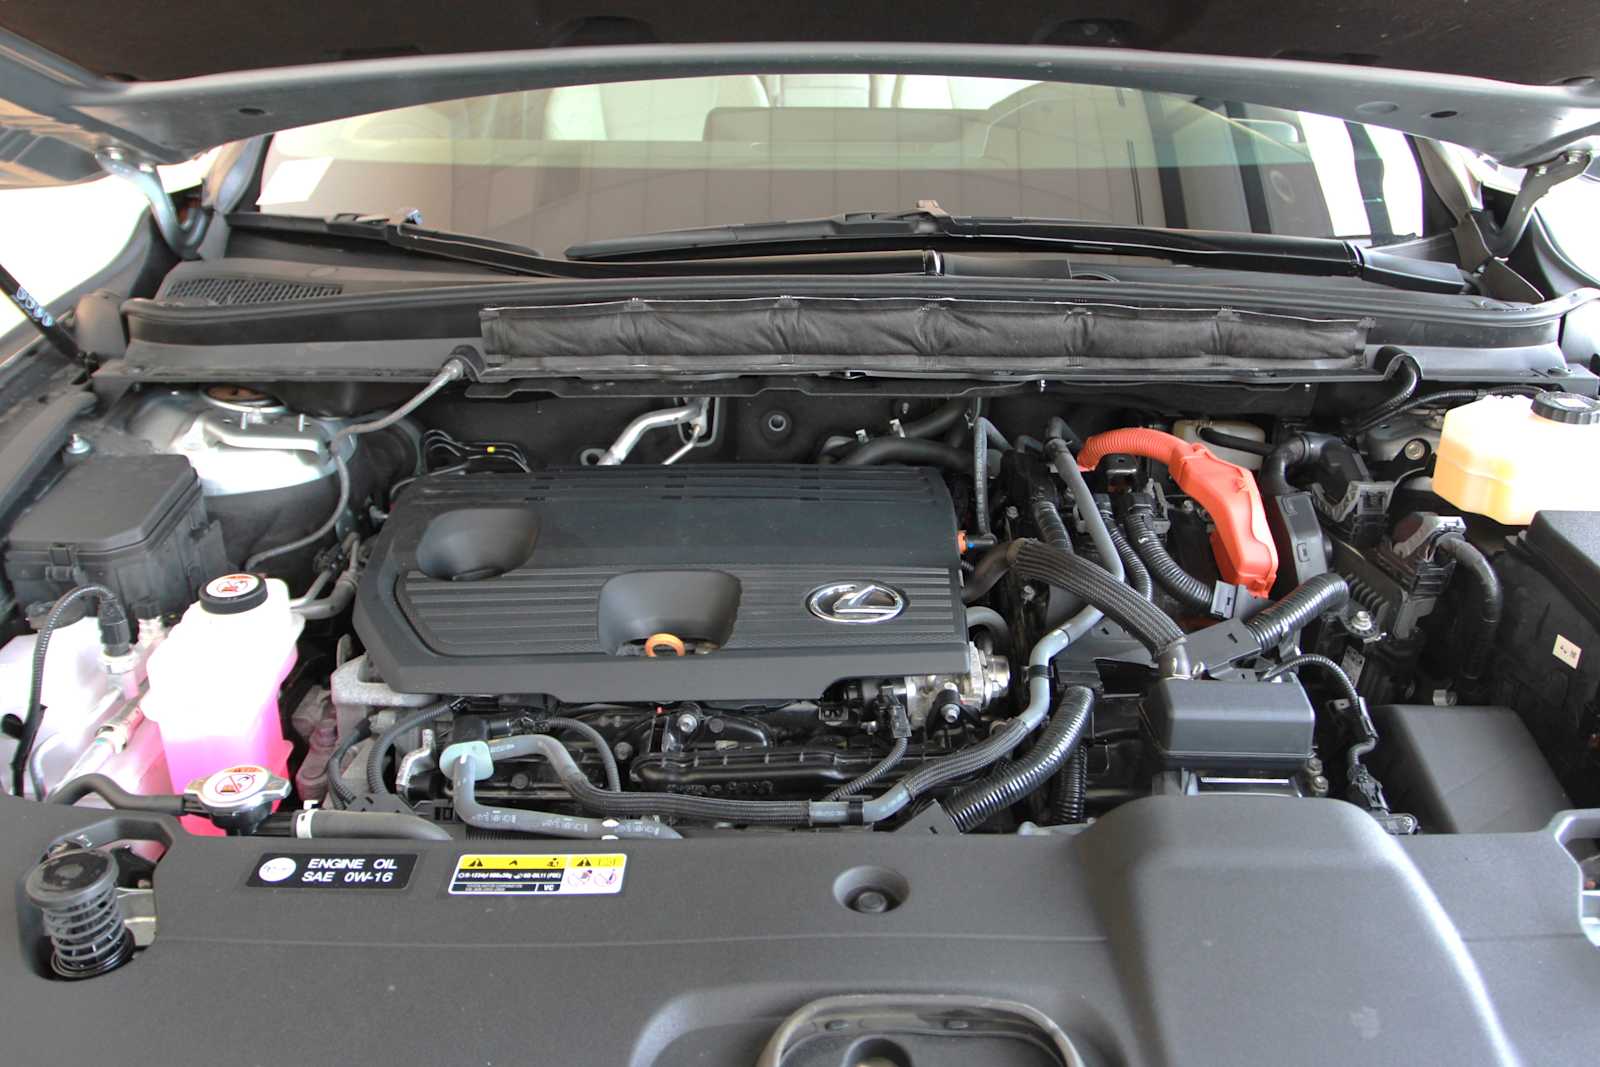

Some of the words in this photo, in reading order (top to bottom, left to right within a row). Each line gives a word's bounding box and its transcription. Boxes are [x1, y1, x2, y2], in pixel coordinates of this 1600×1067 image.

[307, 858, 365, 869] ENGINE
[373, 858, 398, 869] OIL
[301, 871, 335, 882] SAE
[344, 871, 393, 883] 0W-16
